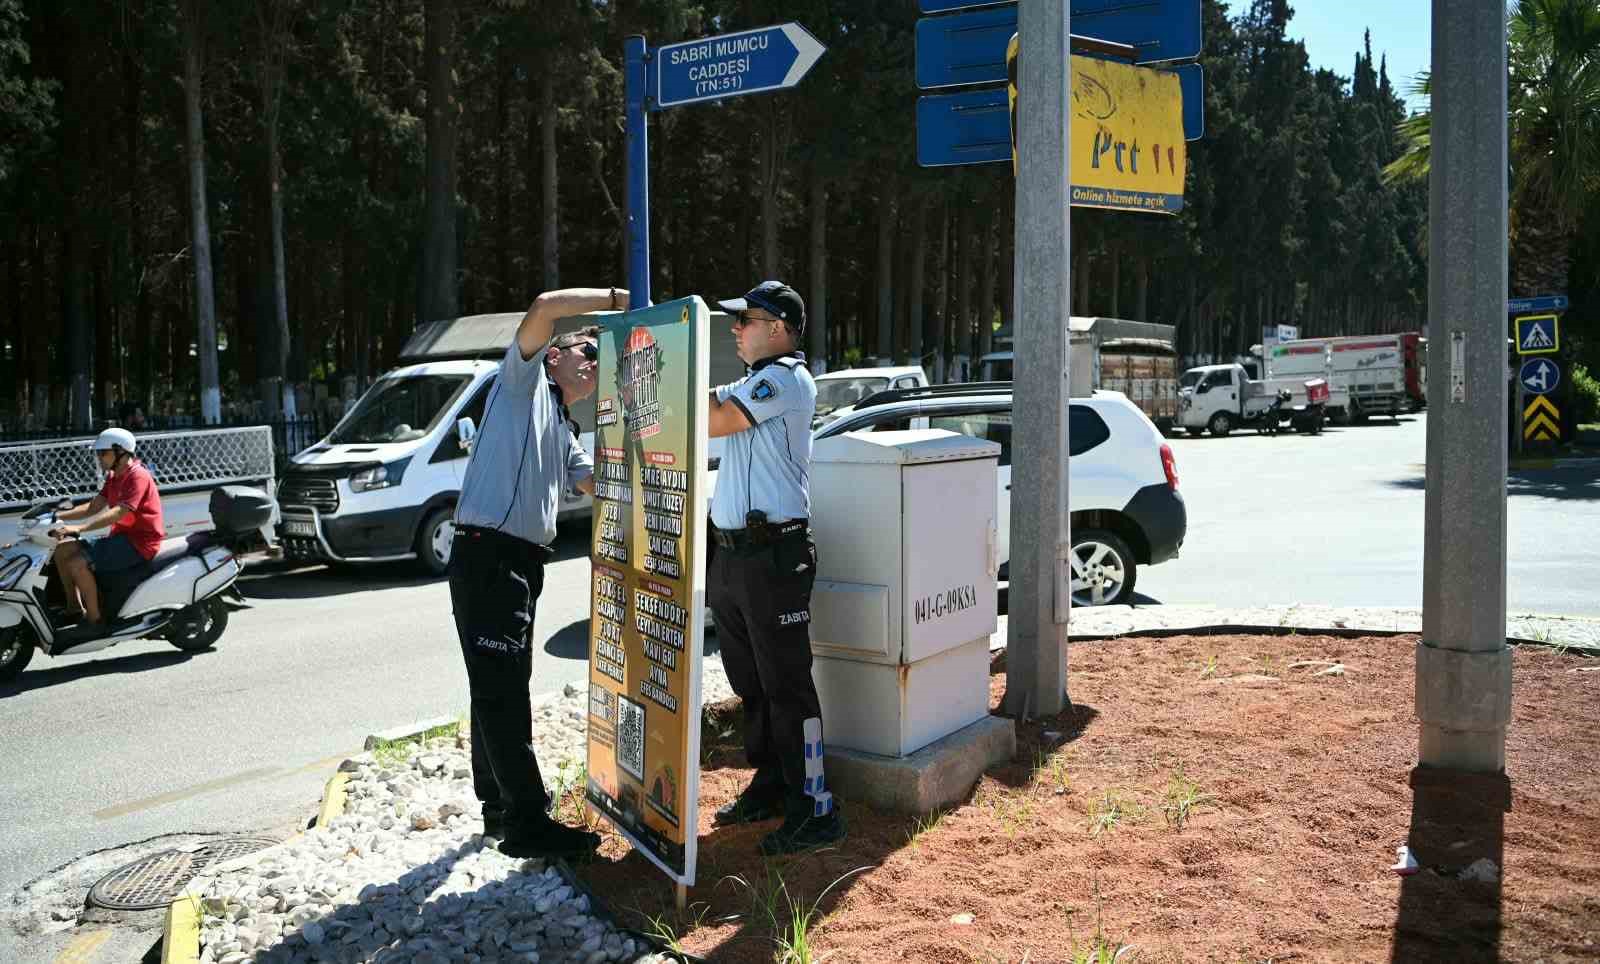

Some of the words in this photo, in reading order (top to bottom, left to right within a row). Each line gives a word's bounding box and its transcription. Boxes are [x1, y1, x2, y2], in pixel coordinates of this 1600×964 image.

[671, 41, 713, 65] SABRİ
[716, 35, 769, 58] MUMCU
[688, 54, 751, 81] CADDESİ
[695, 76, 743, 96] (TN:51)
[1072, 187, 1104, 202] Online
[640, 467, 660, 486] EMRE
[662, 469, 687, 490] AYDIN
[635, 592, 686, 626] SEKSENDÖRT
[915, 585, 977, 625] 041-G-09KSA
[649, 665, 667, 687] AYNA
